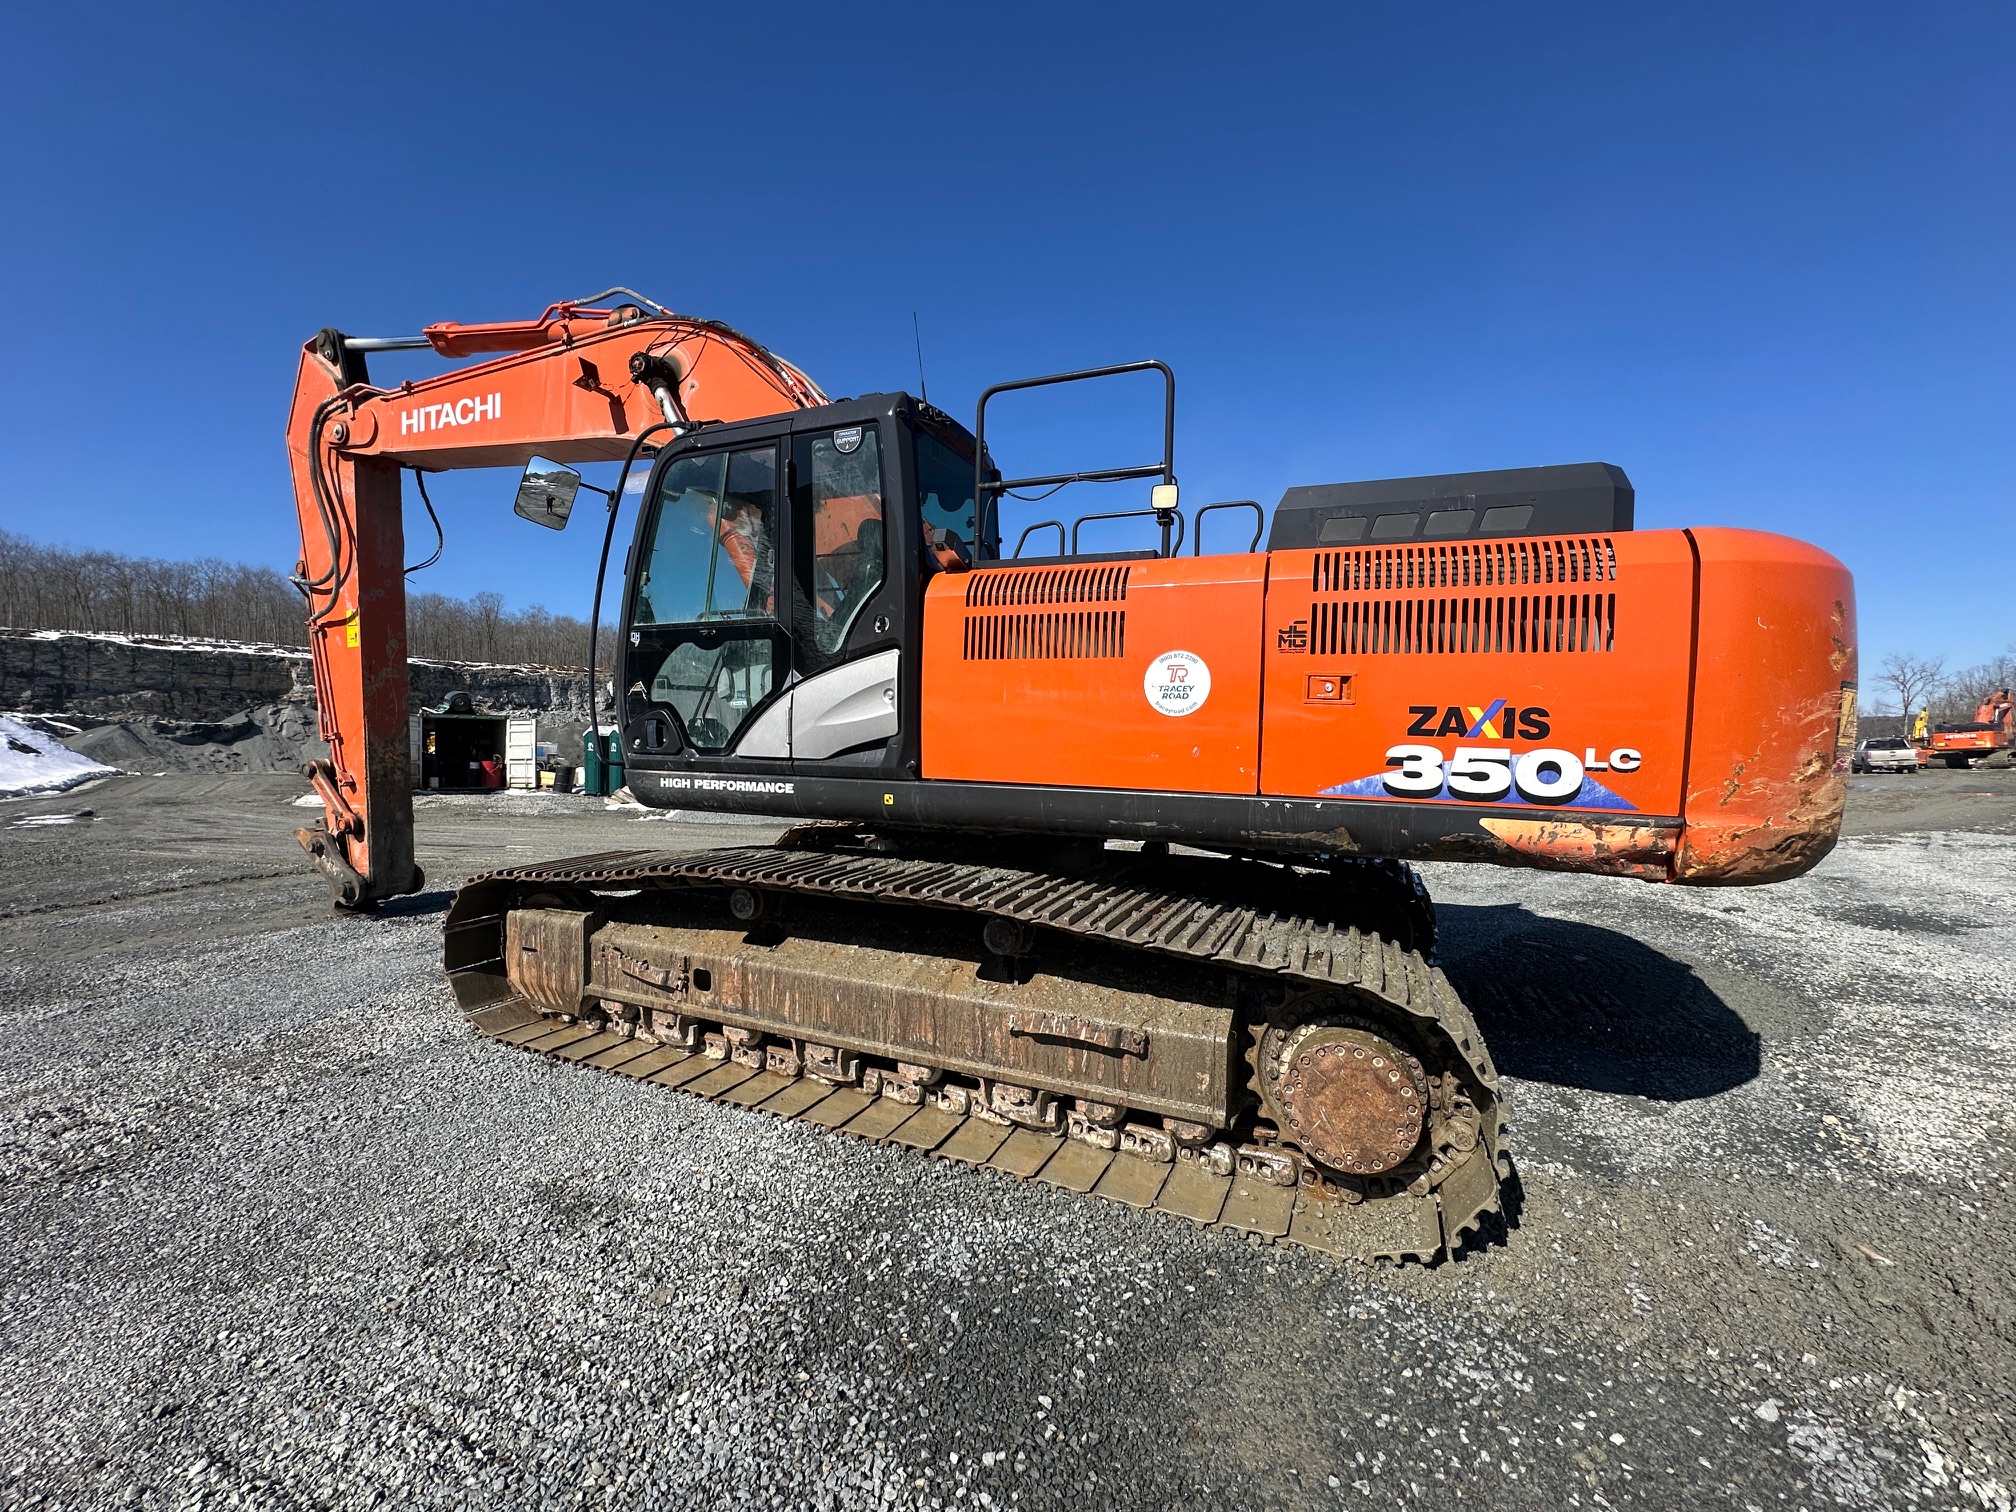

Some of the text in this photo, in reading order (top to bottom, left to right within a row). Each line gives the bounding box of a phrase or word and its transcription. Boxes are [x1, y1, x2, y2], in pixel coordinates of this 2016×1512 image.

[401, 392, 501, 435] HITACHI
[836, 436, 859, 445] SUPPORT
[1407, 699, 1550, 740] ZAXIS
[660, 777, 795, 794] HIGH PERFORMANCE
[1383, 744, 1642, 805] 350 LC
